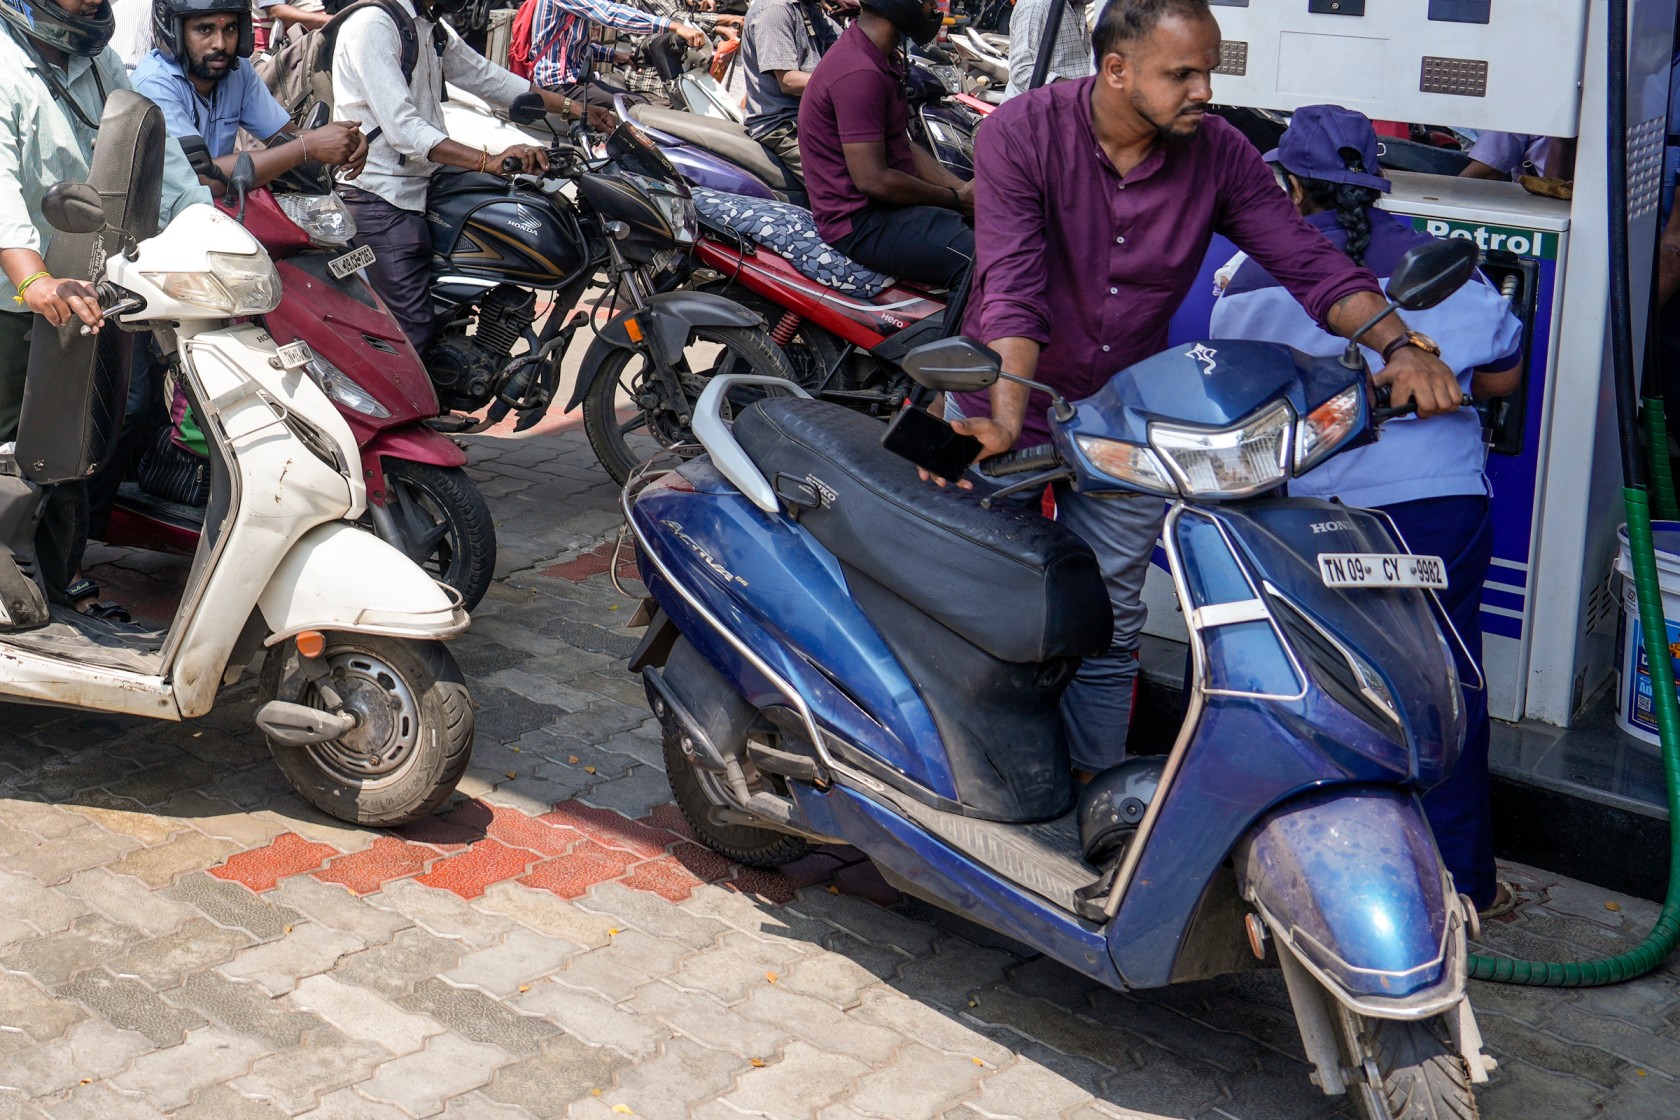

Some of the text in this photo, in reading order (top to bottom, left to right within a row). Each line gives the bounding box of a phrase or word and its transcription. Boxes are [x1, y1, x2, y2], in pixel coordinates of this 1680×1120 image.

[507, 219, 539, 237] HONDA
[881, 312, 904, 328] Hero
[1323, 557, 1443, 585] TN 09 CY 9982
